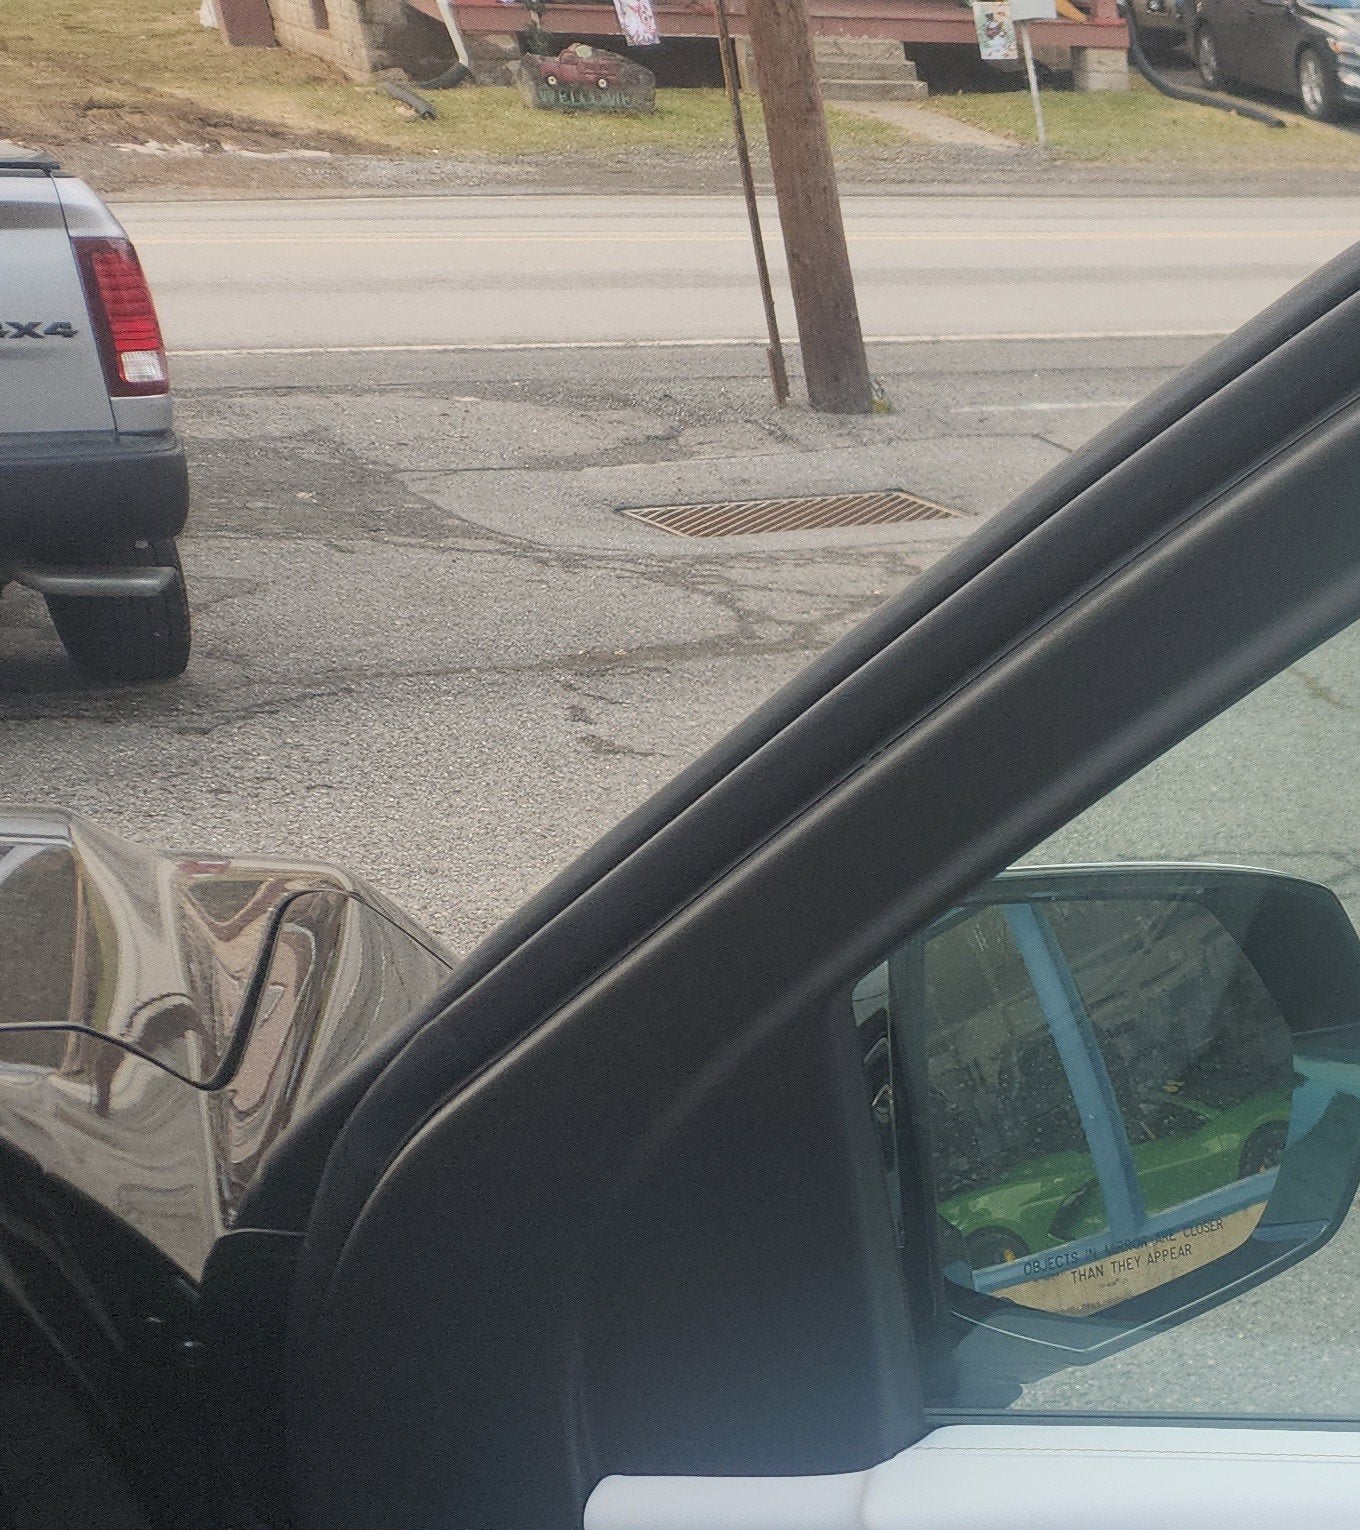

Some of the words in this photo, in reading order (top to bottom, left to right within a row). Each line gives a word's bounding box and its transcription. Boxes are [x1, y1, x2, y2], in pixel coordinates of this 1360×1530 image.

[1023, 1251, 1078, 1276] OBJECTS
[1182, 1218, 1224, 1239] CLOSER
[1070, 1264, 1105, 1284] THAN
[1110, 1255, 1141, 1273] THEY
[1146, 1243, 1193, 1265] APPEAR
